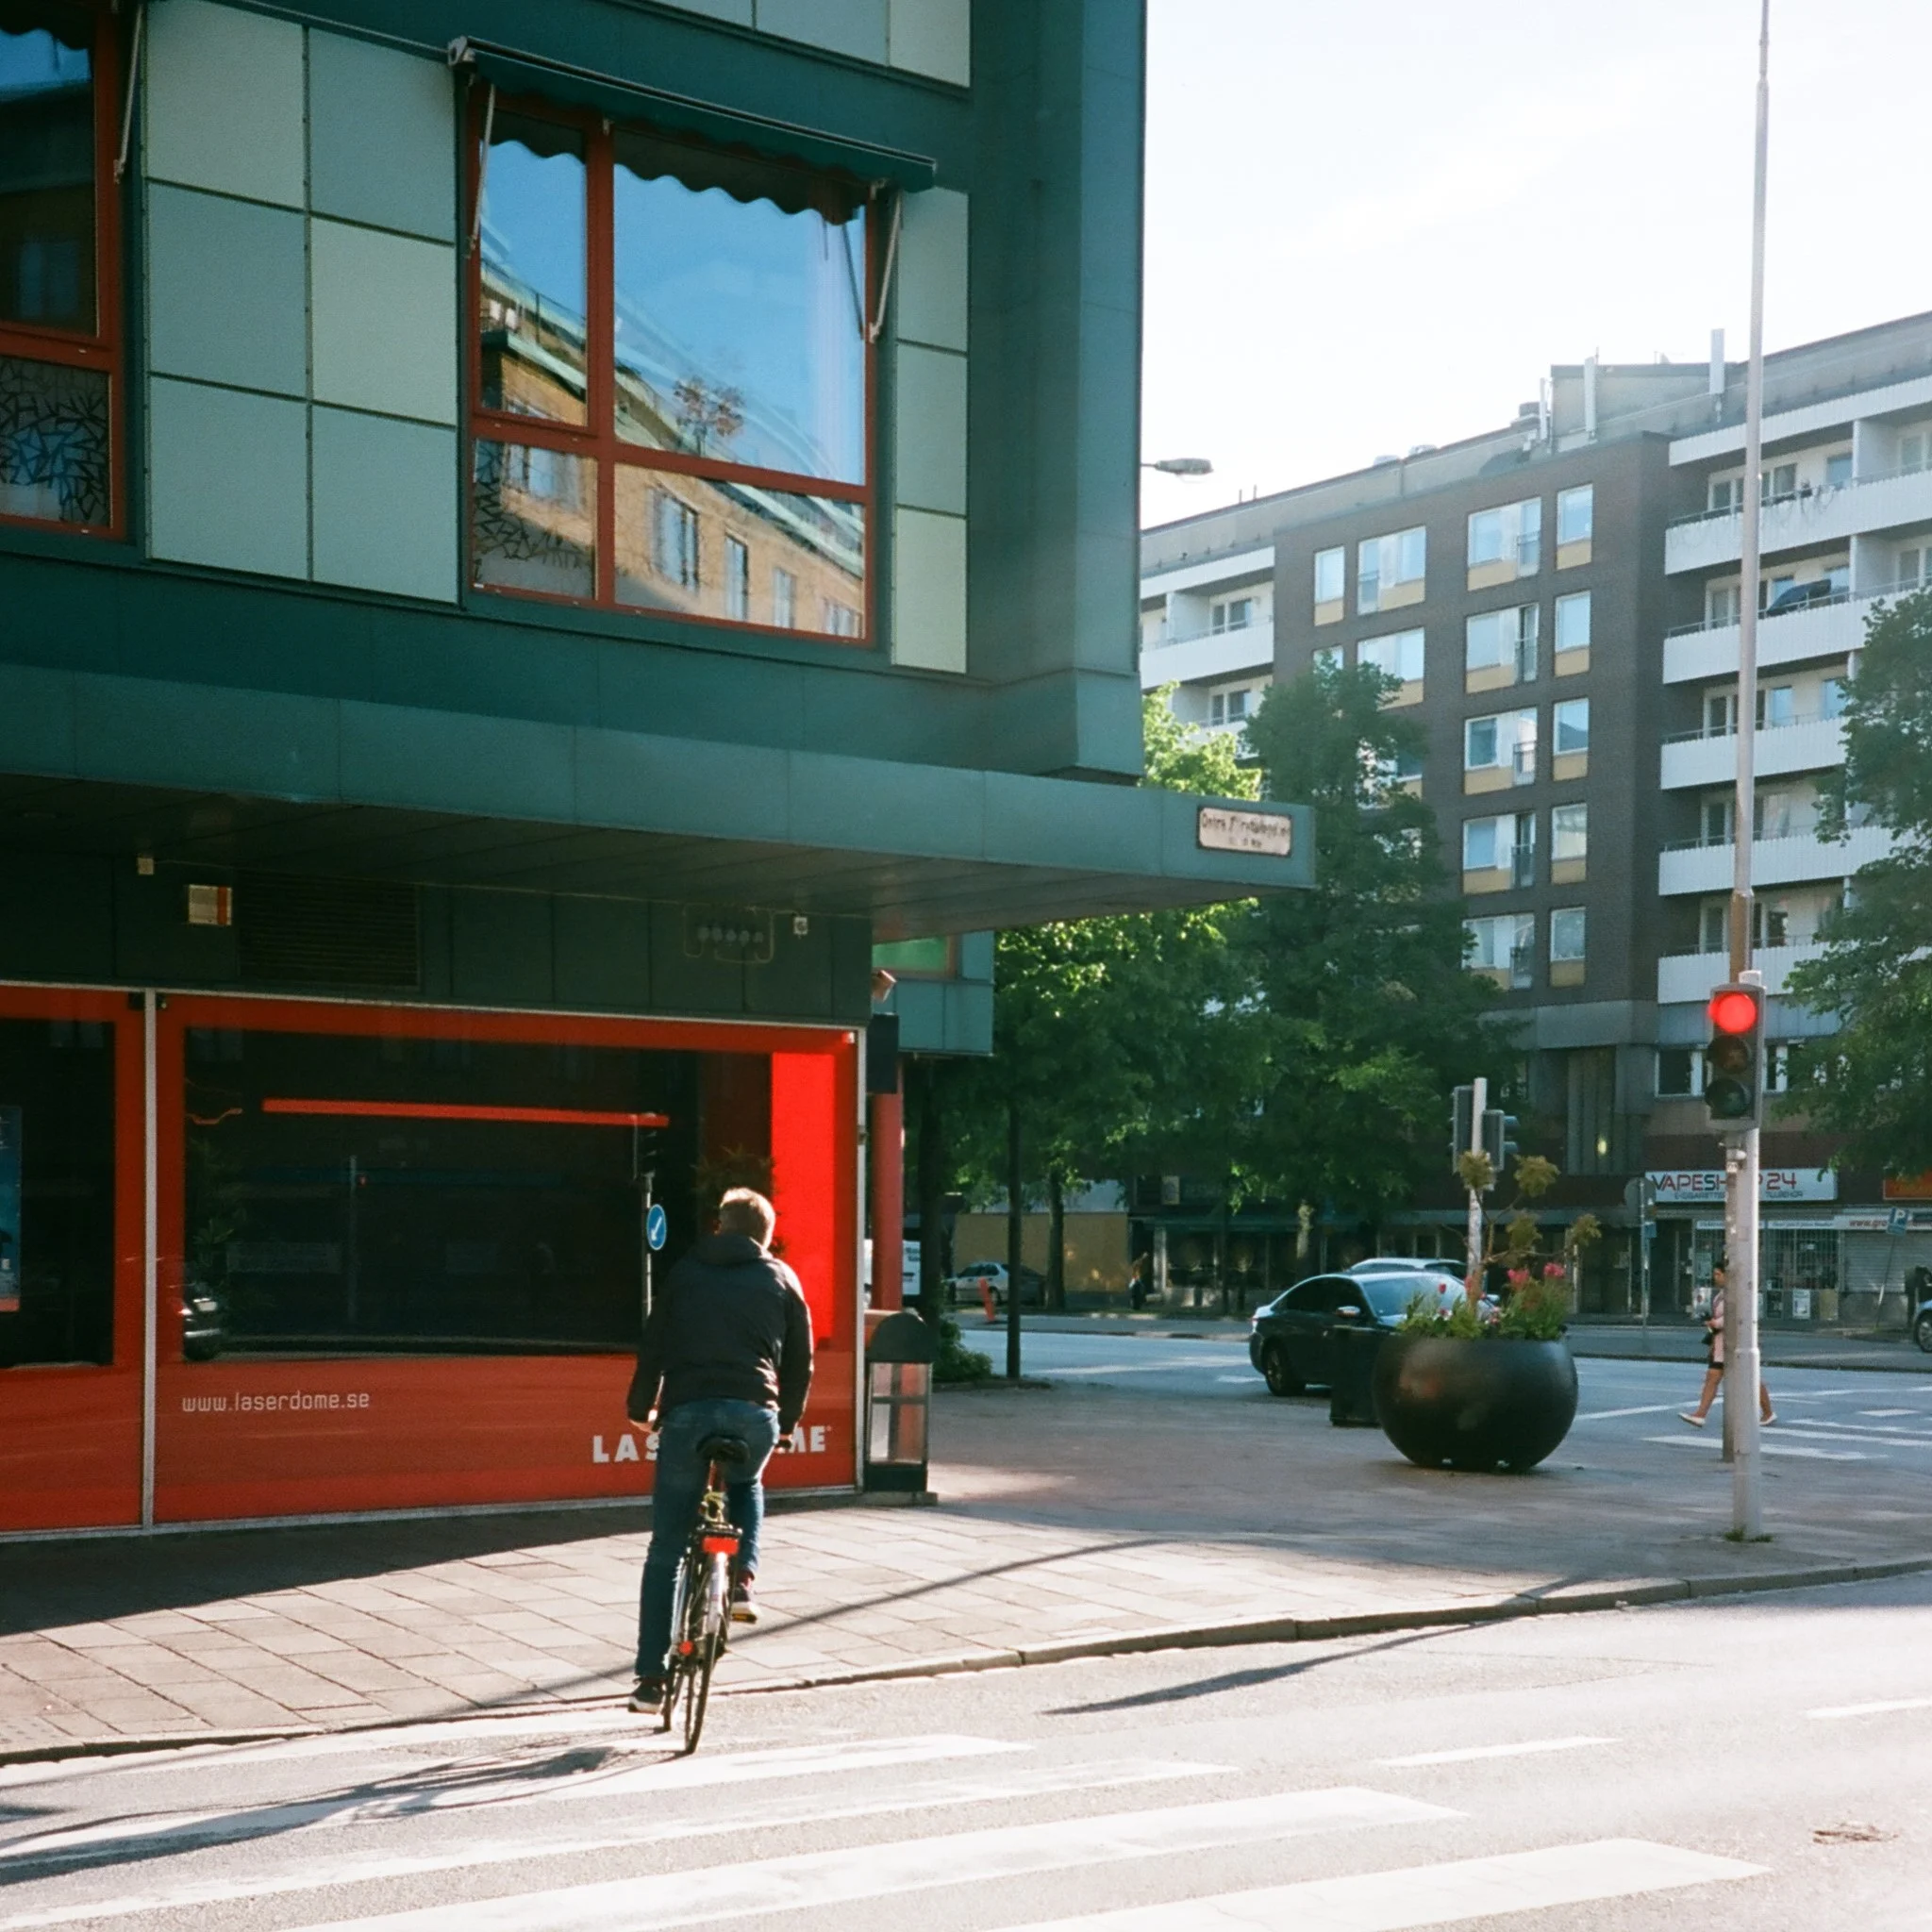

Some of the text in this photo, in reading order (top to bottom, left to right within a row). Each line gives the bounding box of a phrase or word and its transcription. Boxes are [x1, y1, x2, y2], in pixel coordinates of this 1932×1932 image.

[1766, 1172, 1797, 1190] 24
[1893, 1208, 1907, 1224] P
[182, 1391, 370, 1412] www.laserdome.se
[592, 1425, 826, 1463] LASME
